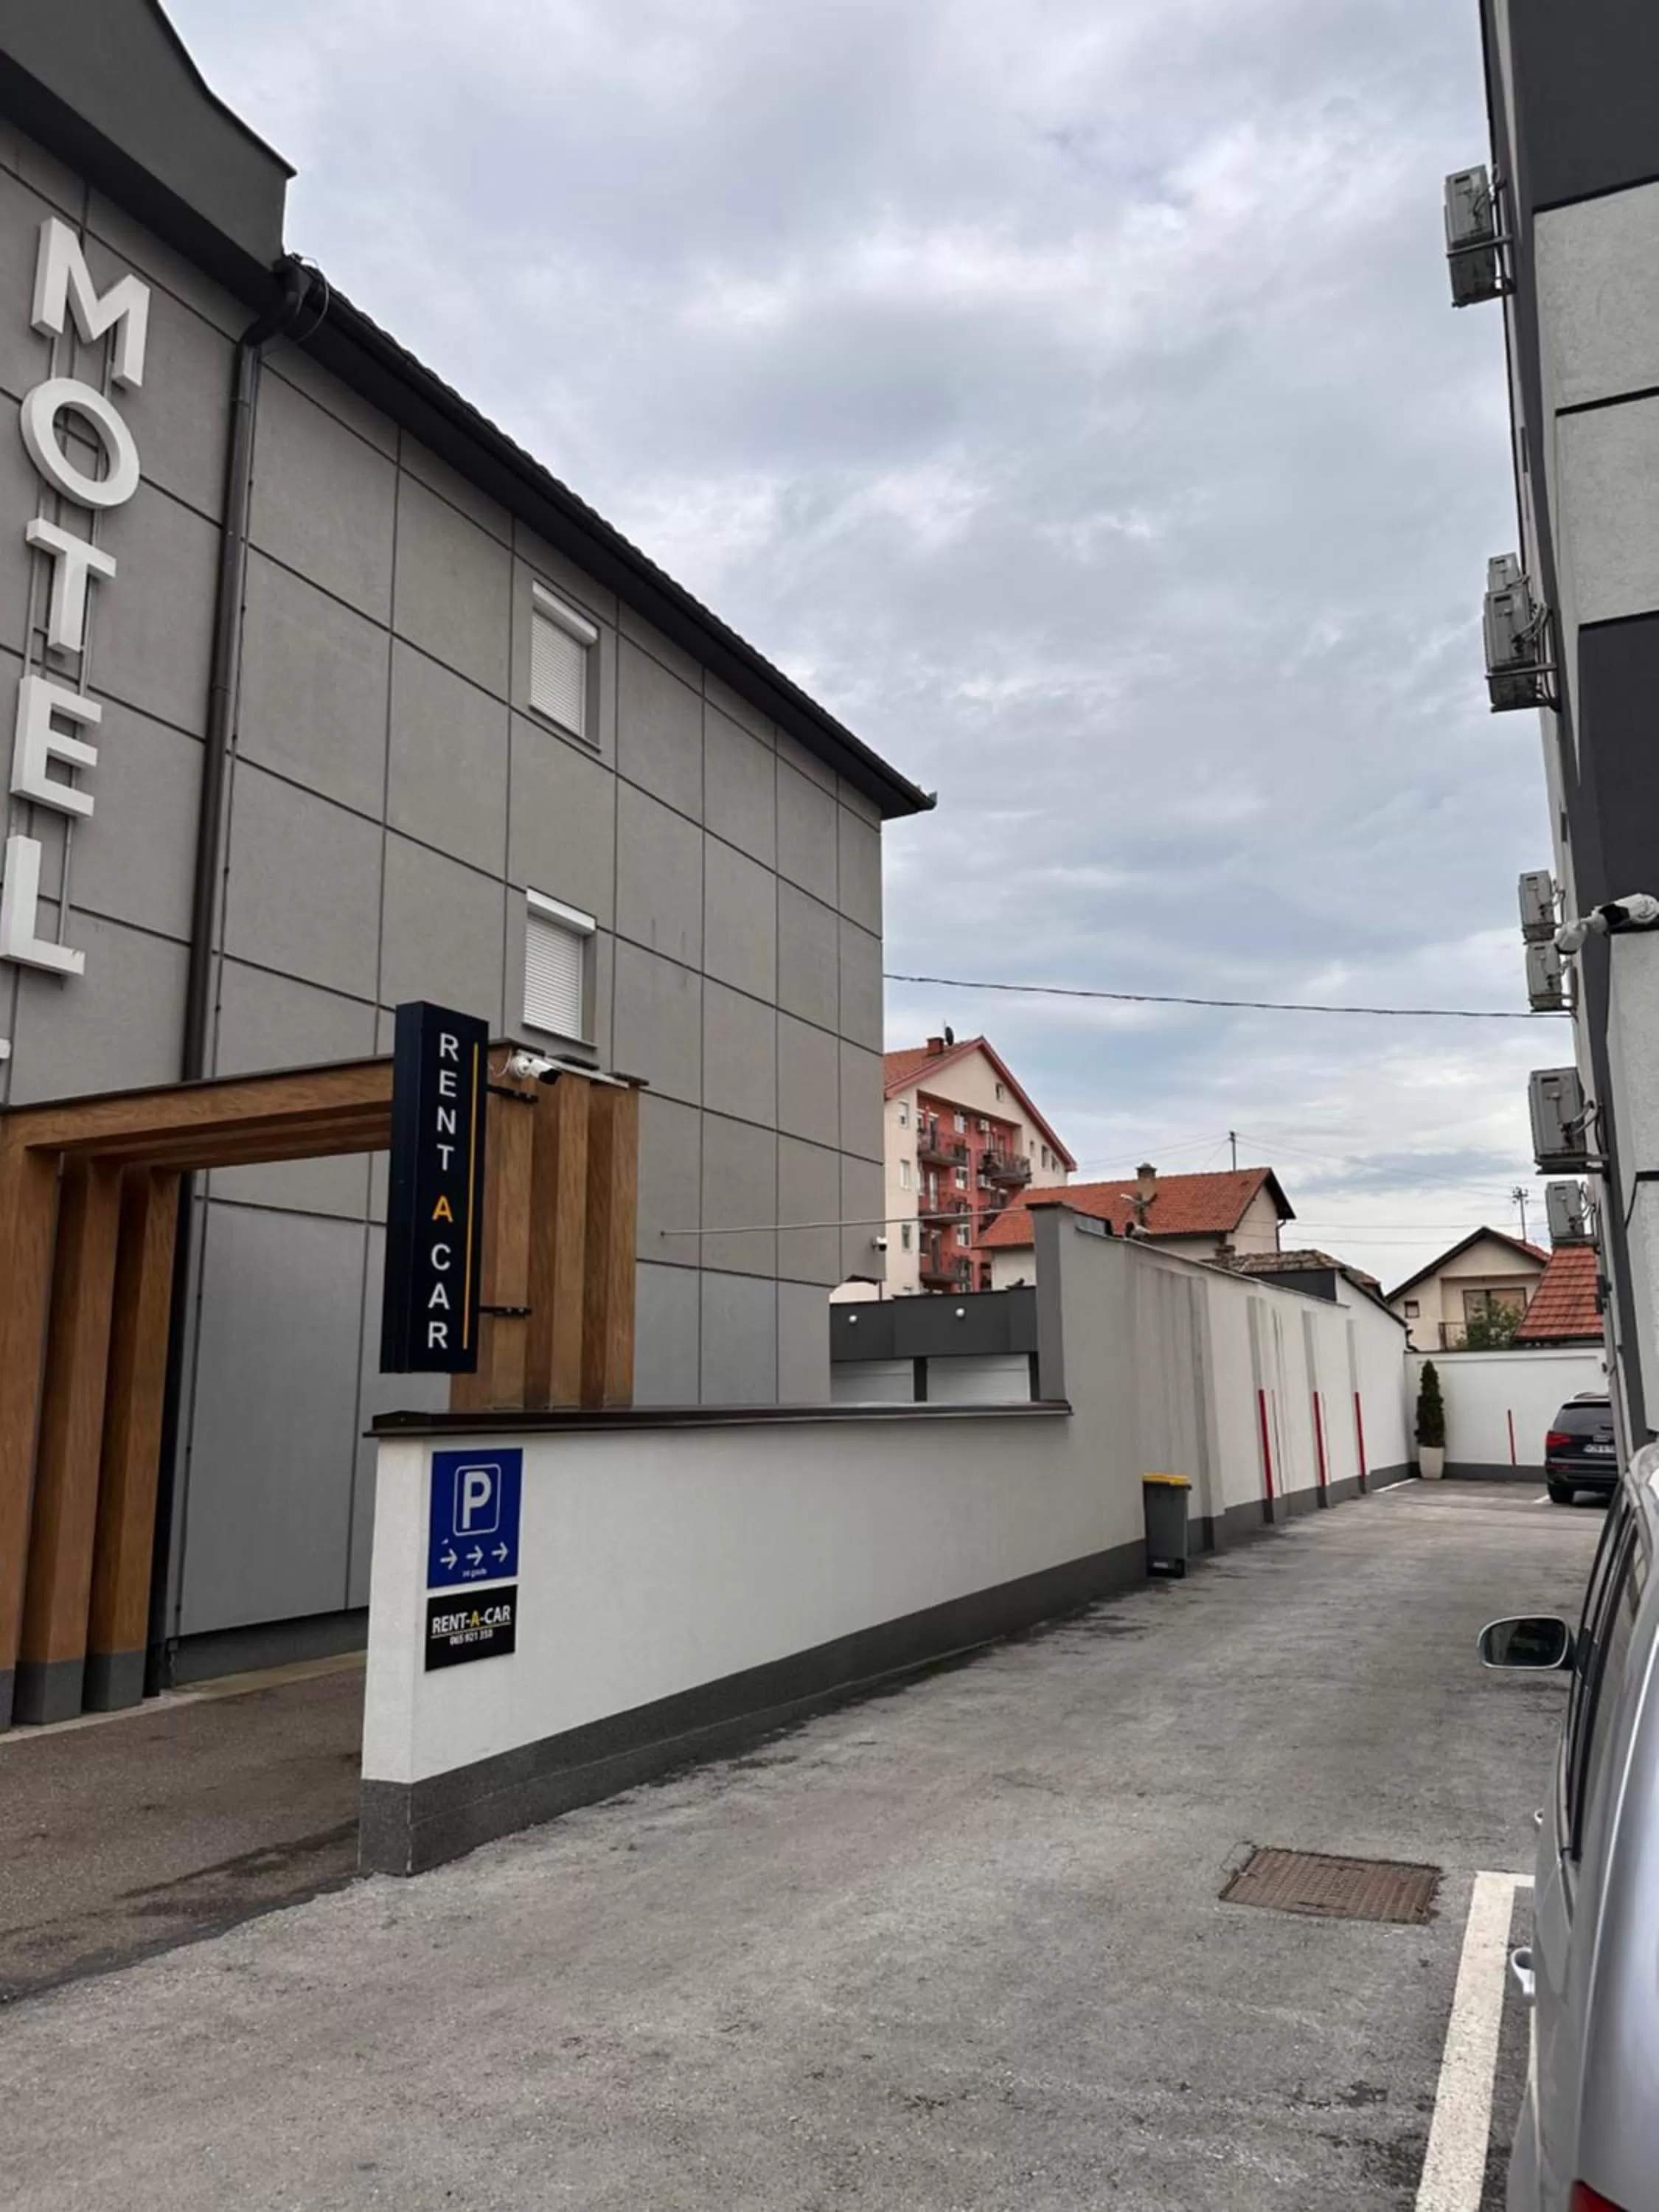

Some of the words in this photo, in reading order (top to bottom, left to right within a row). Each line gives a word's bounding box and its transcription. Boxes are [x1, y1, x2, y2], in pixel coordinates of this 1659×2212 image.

[1, 216, 150, 975] MOTEL
[436, 1032, 459, 1172] RENT
[431, 1195, 453, 1222] A
[428, 1243, 451, 1349] CAR
[462, 1470, 492, 1530] P
[431, 1604, 511, 1634] RENT-A-CAR
